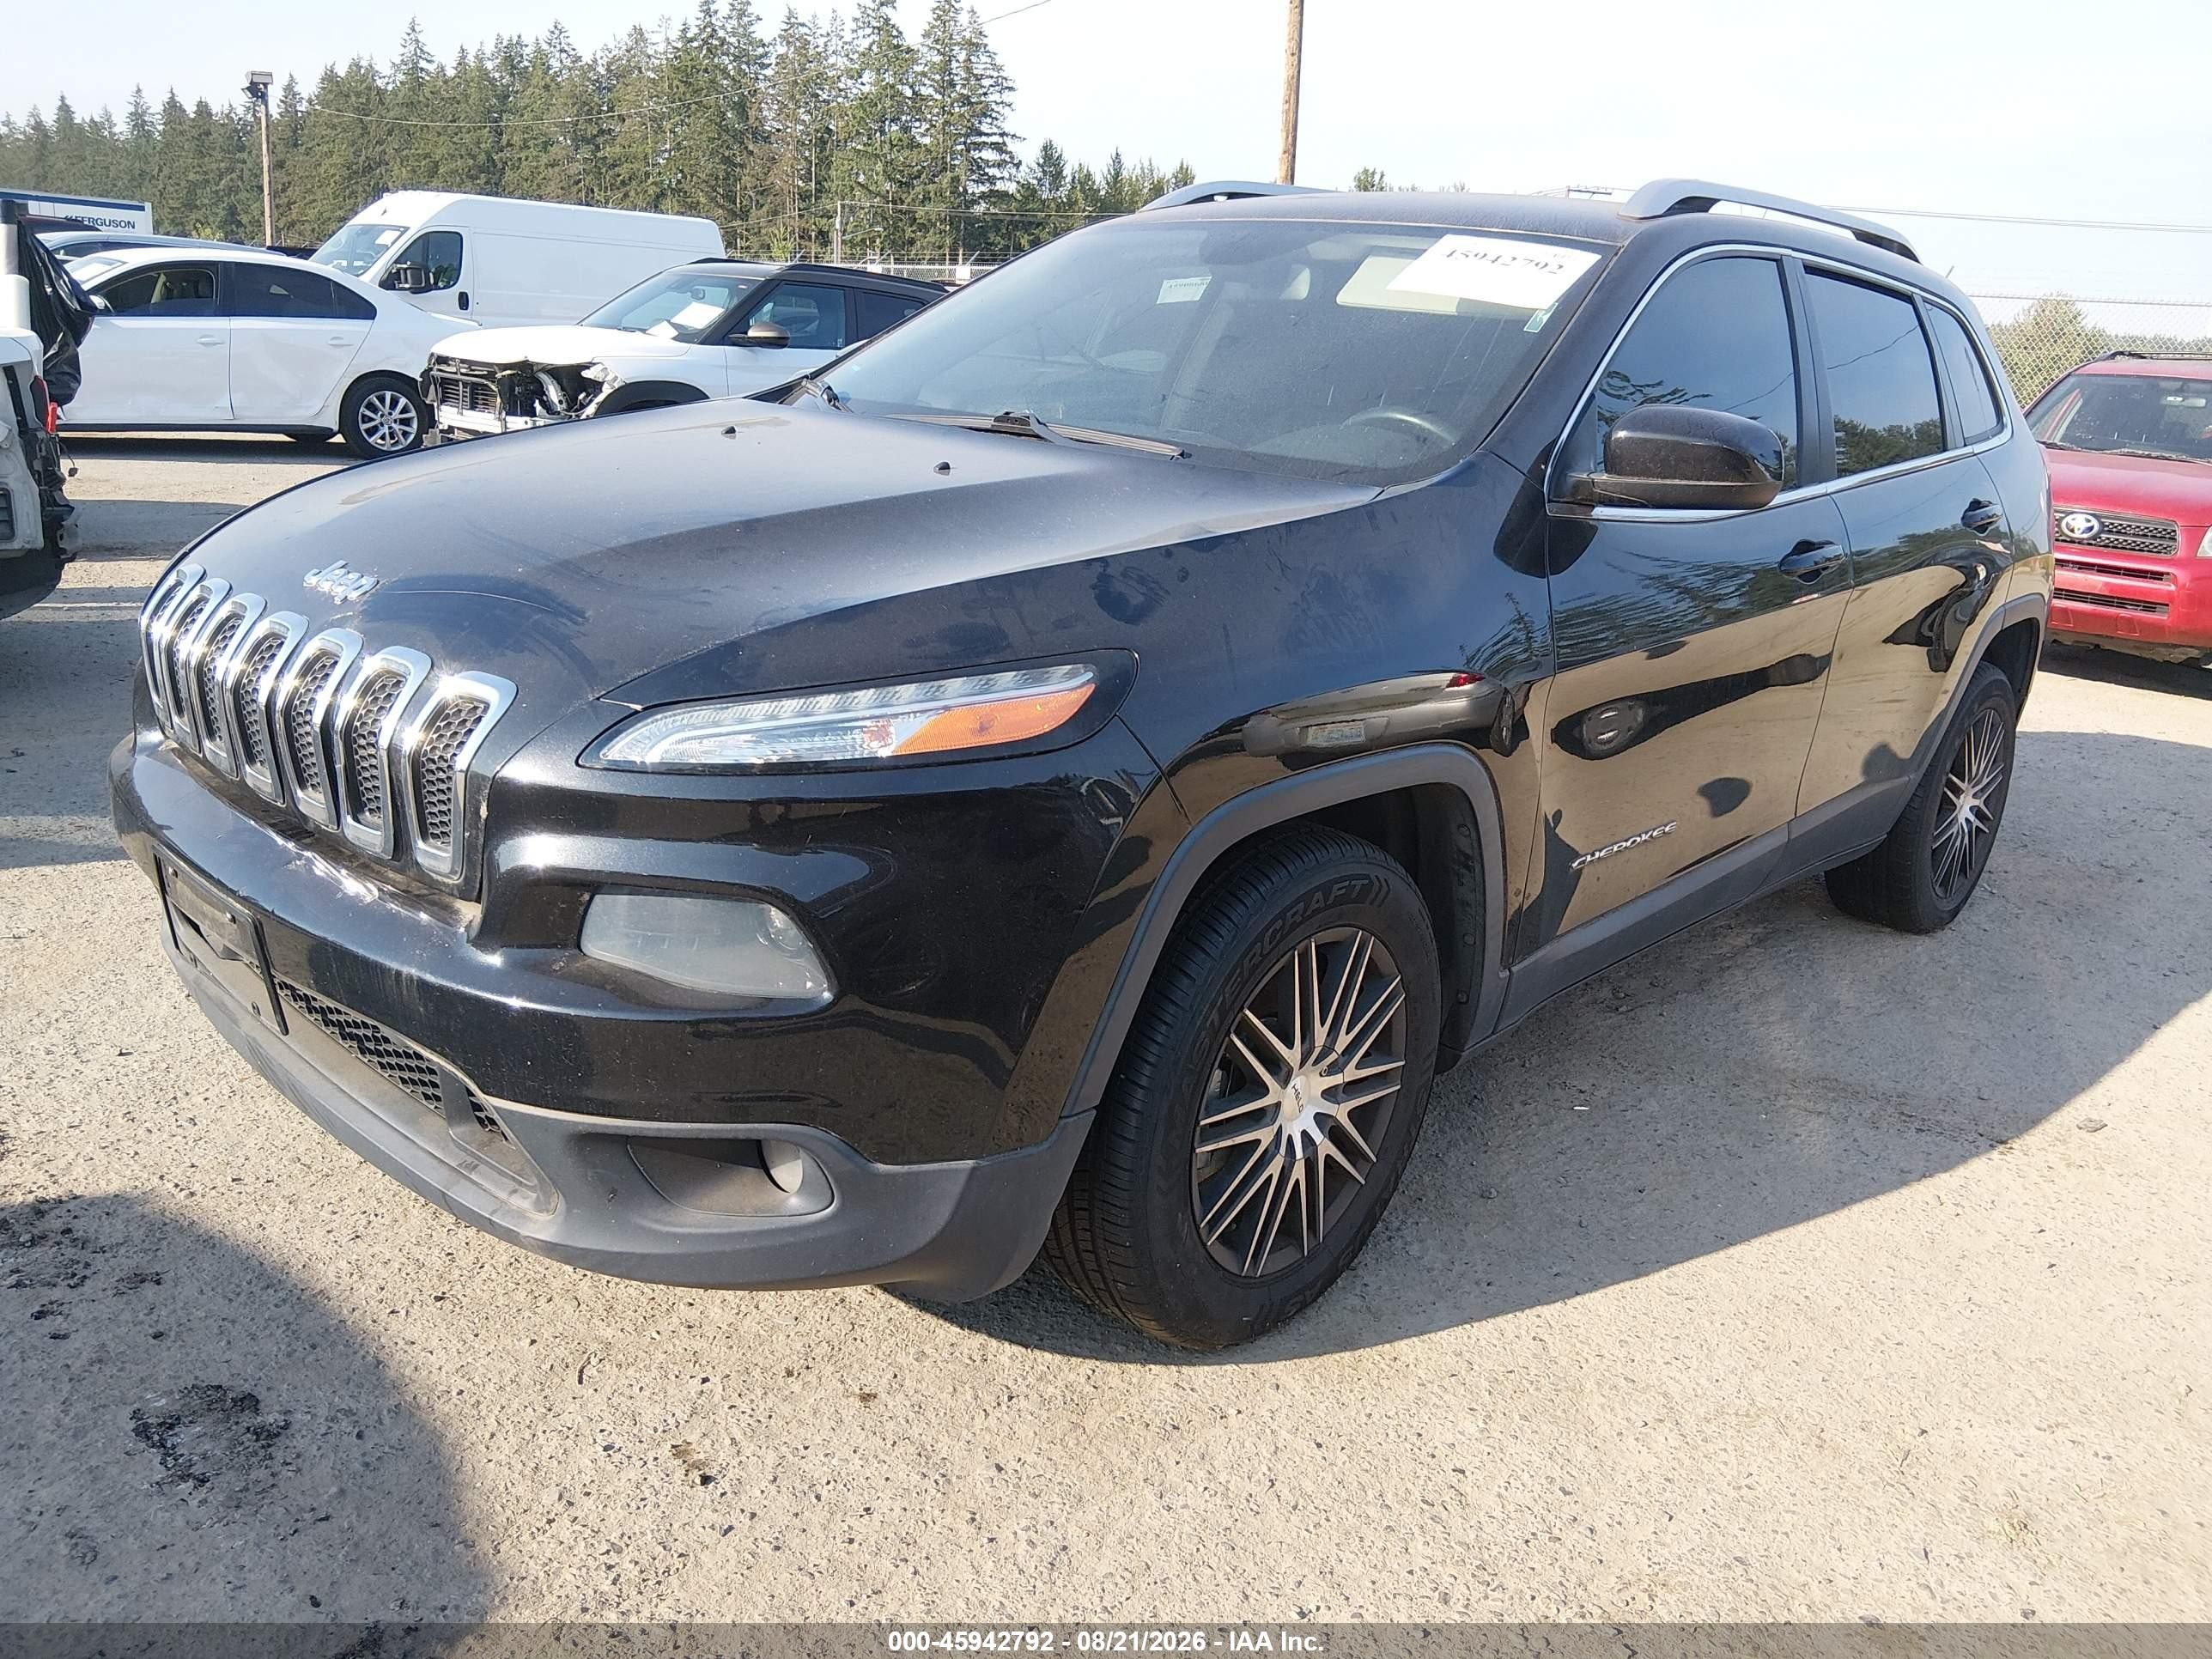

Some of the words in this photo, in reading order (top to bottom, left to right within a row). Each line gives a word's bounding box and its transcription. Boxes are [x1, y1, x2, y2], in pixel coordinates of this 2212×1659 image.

[303, 560, 379, 605] Jeep
[1571, 821, 1677, 871] CHEROKEE
[1180, 878, 1370, 1103] STERCRAFT
